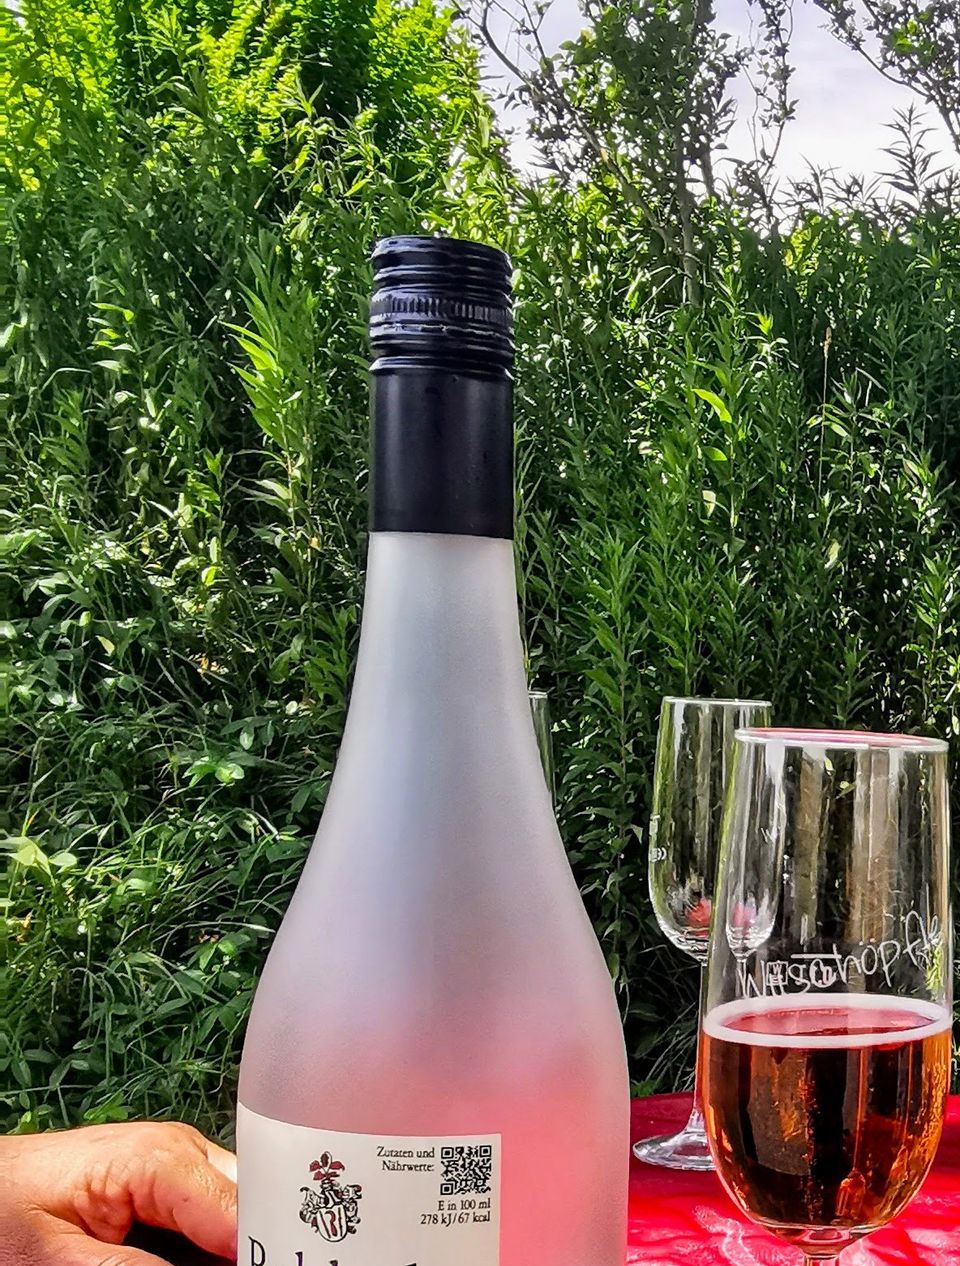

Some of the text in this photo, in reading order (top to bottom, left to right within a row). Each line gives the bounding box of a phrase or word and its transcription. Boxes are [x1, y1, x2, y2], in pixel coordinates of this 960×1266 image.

[376, 1145, 435, 1158] Zutaten und
[382, 1160, 435, 1172] Nährwerte:
[438, 1197, 491, 1212] E in 100 ml
[420, 1214, 439, 1225] 278
[472, 1211, 491, 1223] kcal
